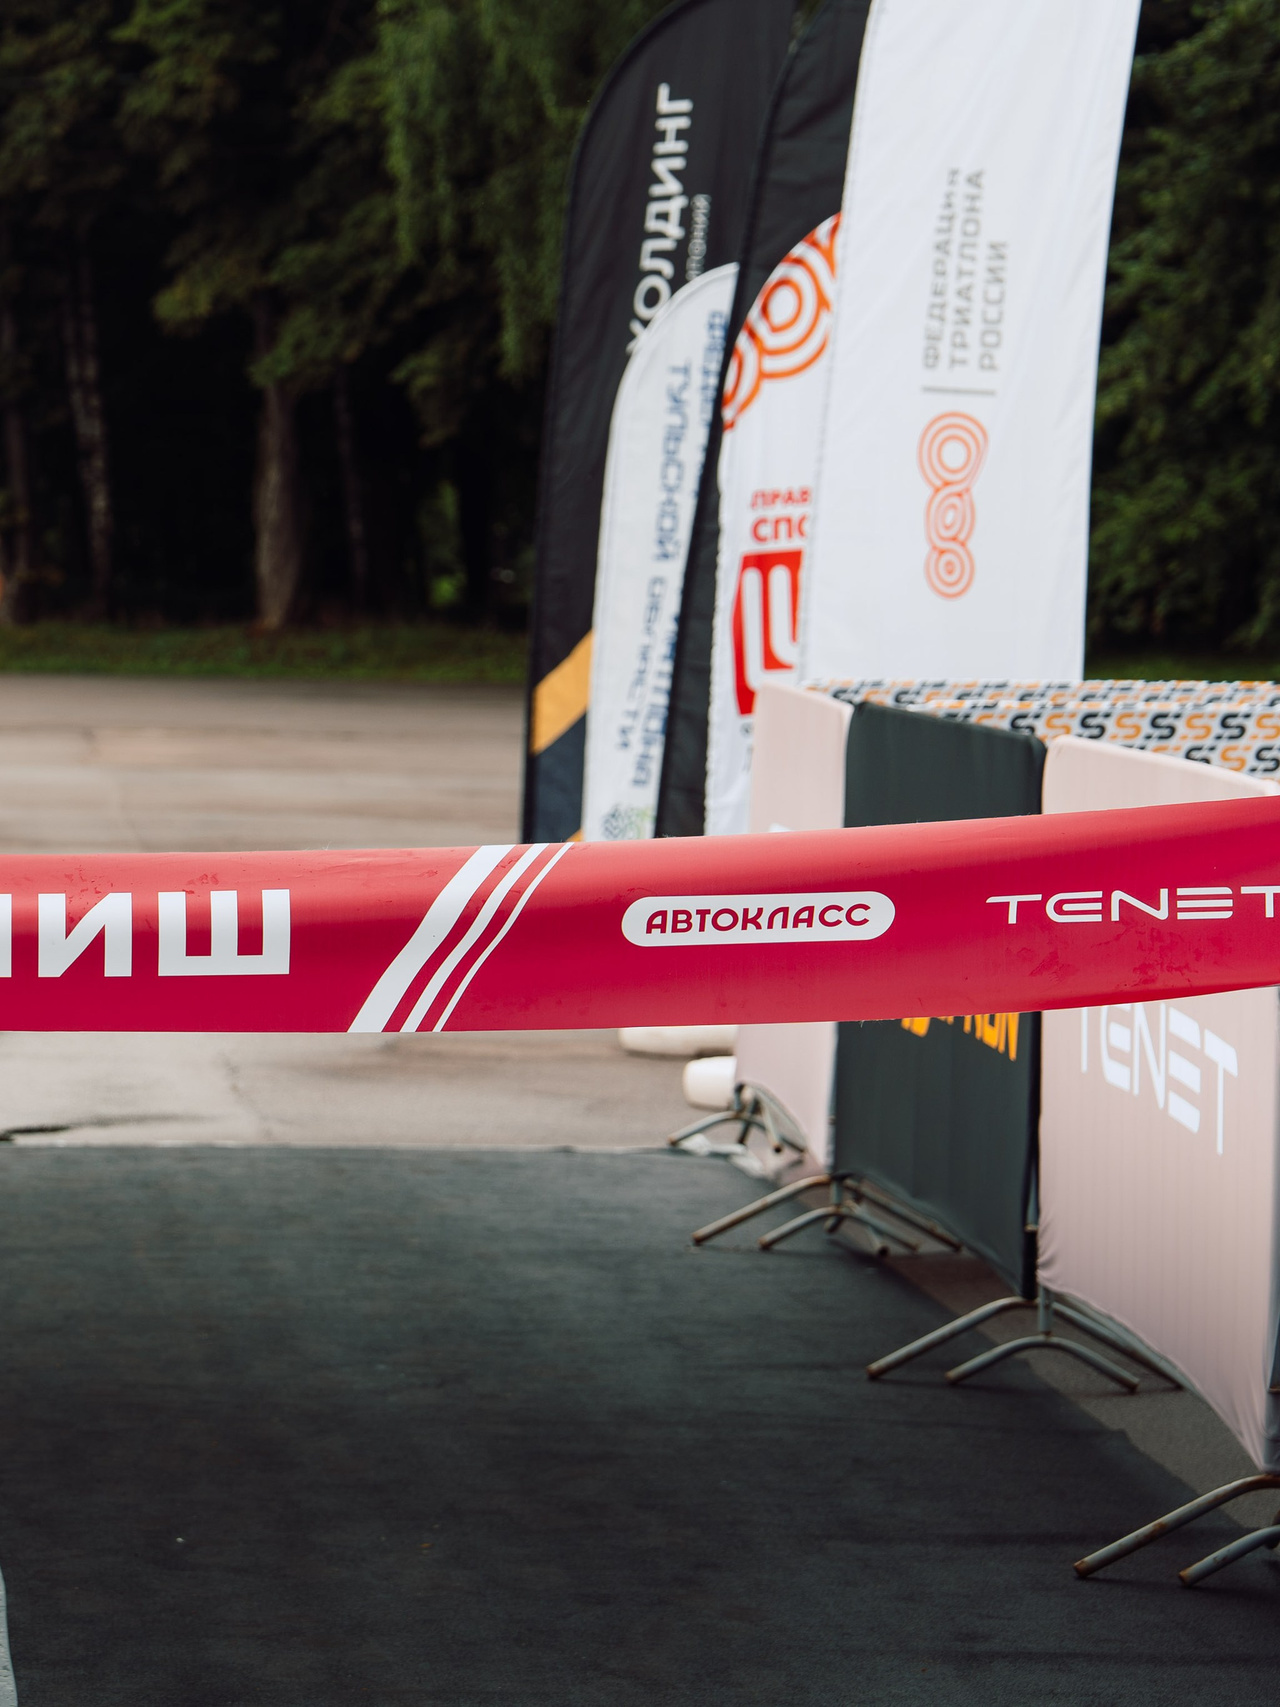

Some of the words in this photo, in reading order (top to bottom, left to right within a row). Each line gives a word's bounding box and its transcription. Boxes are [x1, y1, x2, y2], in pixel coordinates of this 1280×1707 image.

[921, 168, 960, 370] ФЕДЕРАЦИЯ
[948, 168, 986, 371] ТРИАТЛОНА
[978, 241, 1009, 372] РОССИИ
[651, 361, 693, 562] ТУЛЬСКОЙ
[616, 576, 670, 751] ОБЛАСТИ
[645, 903, 872, 935] АВТОКЛАСС
[986, 885, 1280, 925] TENET
